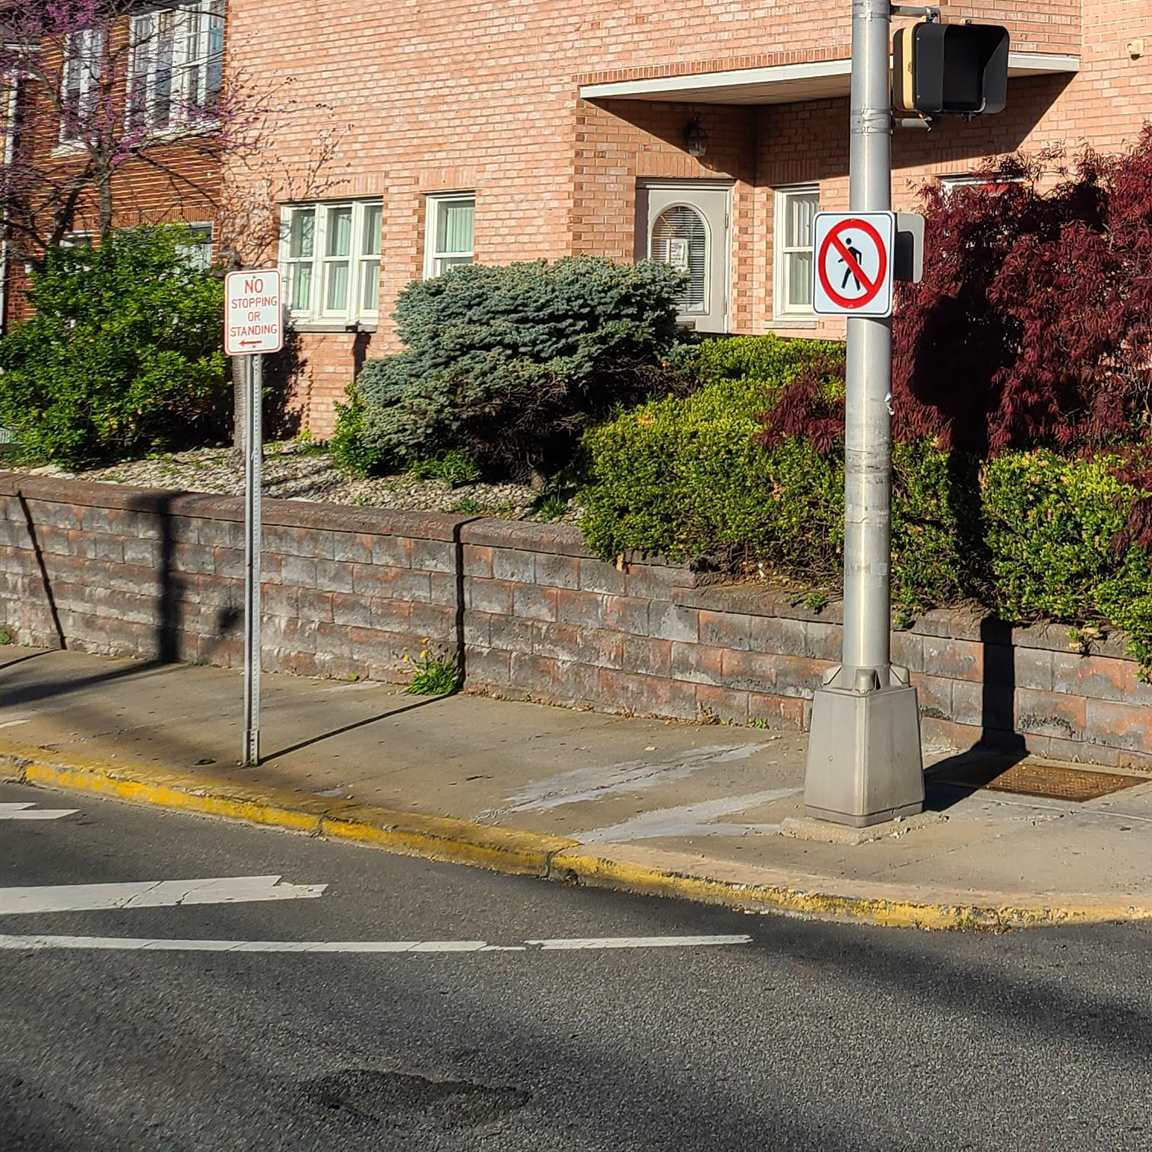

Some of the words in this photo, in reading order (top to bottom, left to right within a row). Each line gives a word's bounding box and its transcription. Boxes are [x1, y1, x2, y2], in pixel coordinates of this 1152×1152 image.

[244, 279, 263, 294] NO
[231, 296, 278, 309] STOPPING
[248, 312, 260, 321] OR
[230, 324, 278, 337] STANDING
